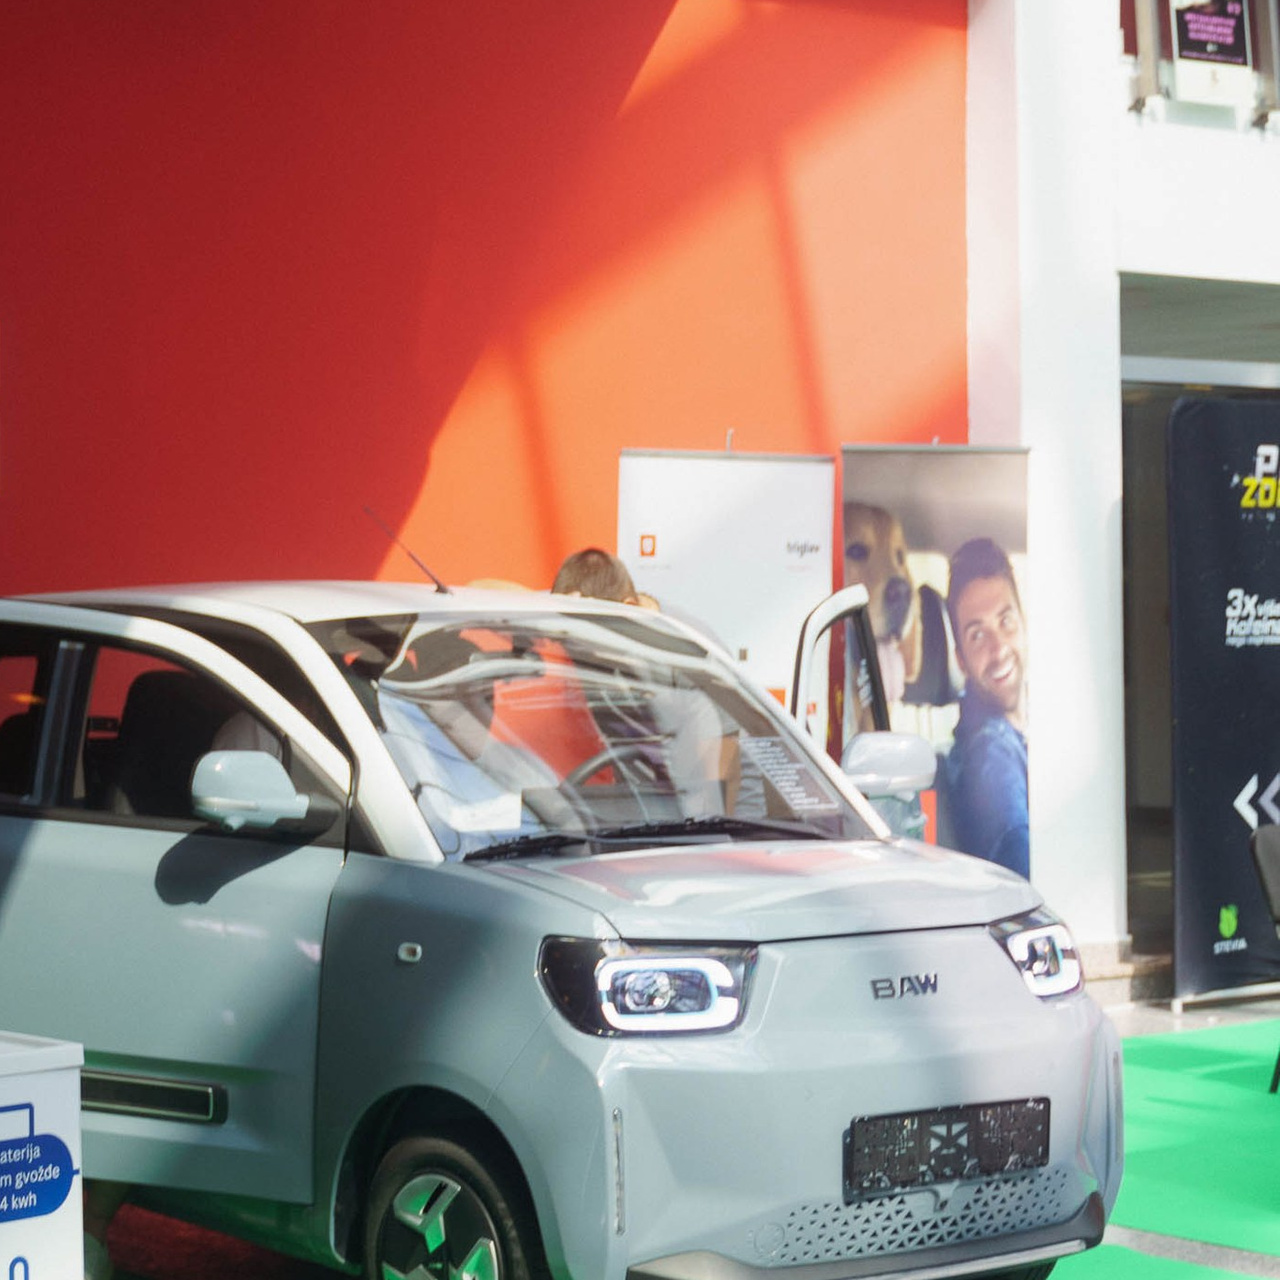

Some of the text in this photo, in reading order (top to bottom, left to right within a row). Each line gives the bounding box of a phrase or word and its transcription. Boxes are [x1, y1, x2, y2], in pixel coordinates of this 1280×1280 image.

[1240, 476, 1280, 509] ZO
[870, 972, 938, 1000] BAW
[11, 1191, 37, 1211] kwh
